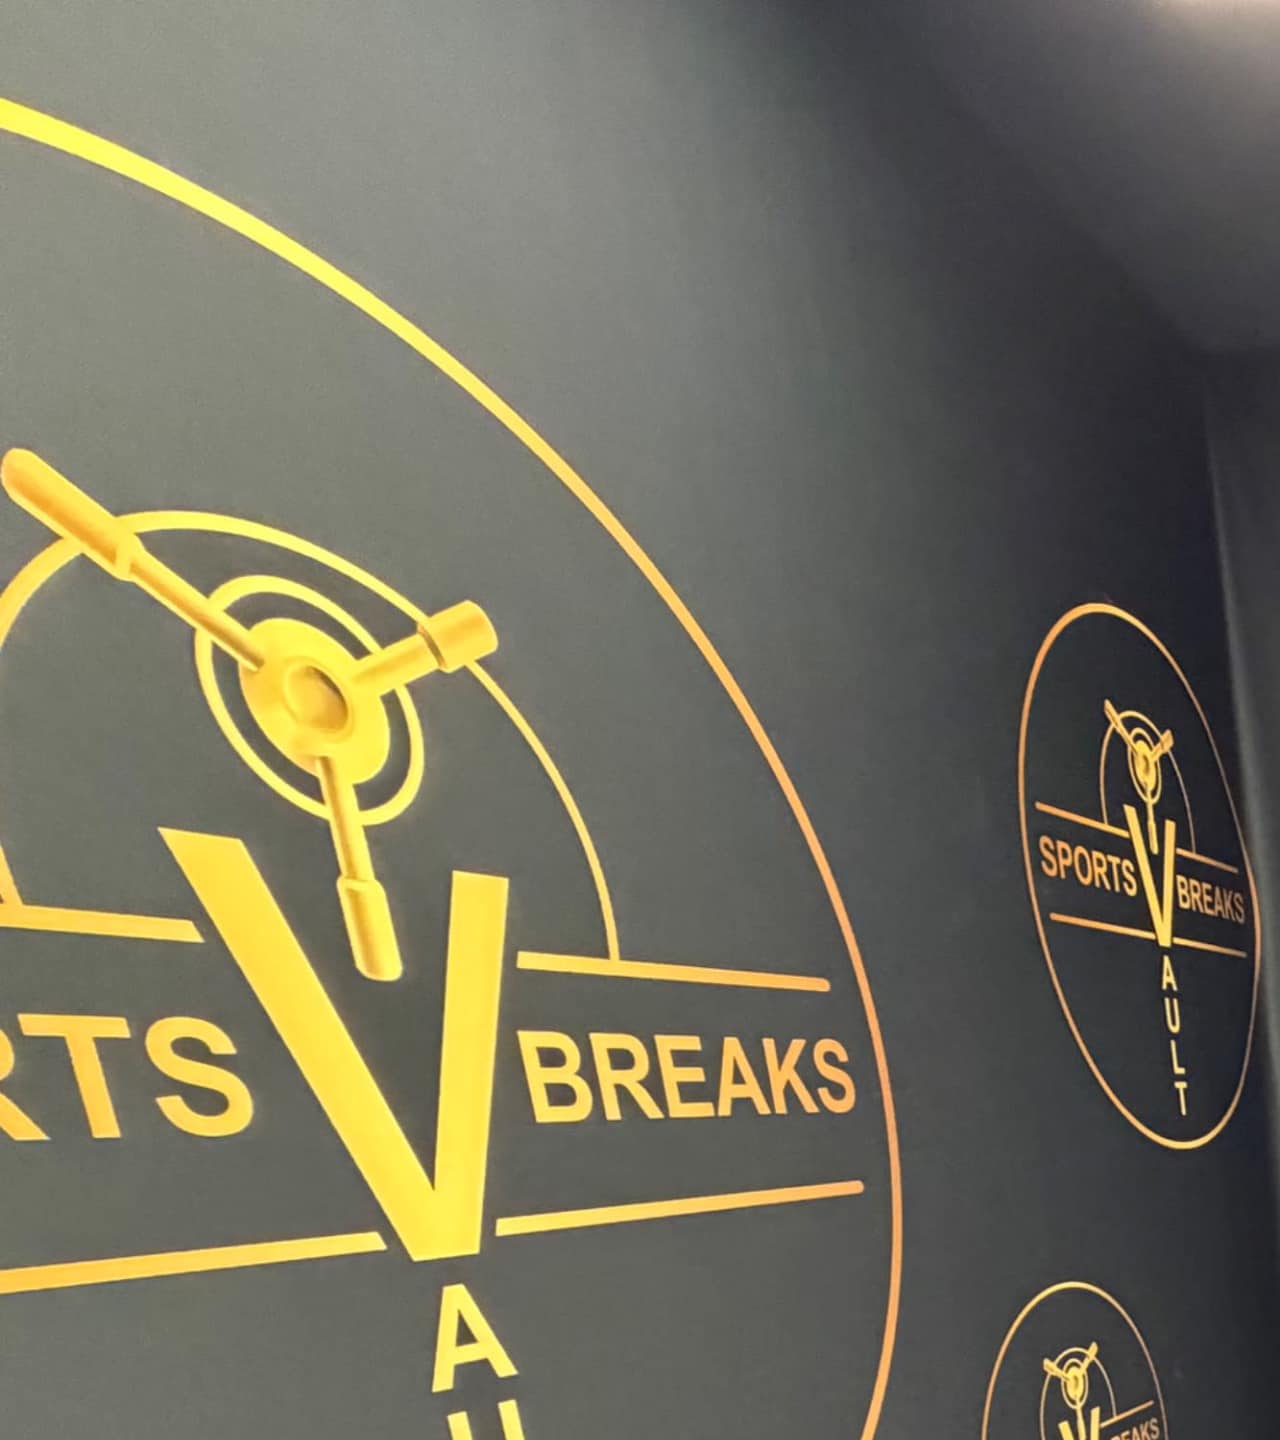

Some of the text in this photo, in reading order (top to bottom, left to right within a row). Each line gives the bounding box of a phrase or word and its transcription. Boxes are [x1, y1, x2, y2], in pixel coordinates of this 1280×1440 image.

[1038, 834, 1246, 925] SPORTS BREAKS
[516, 1030, 857, 1123] BREAKS
